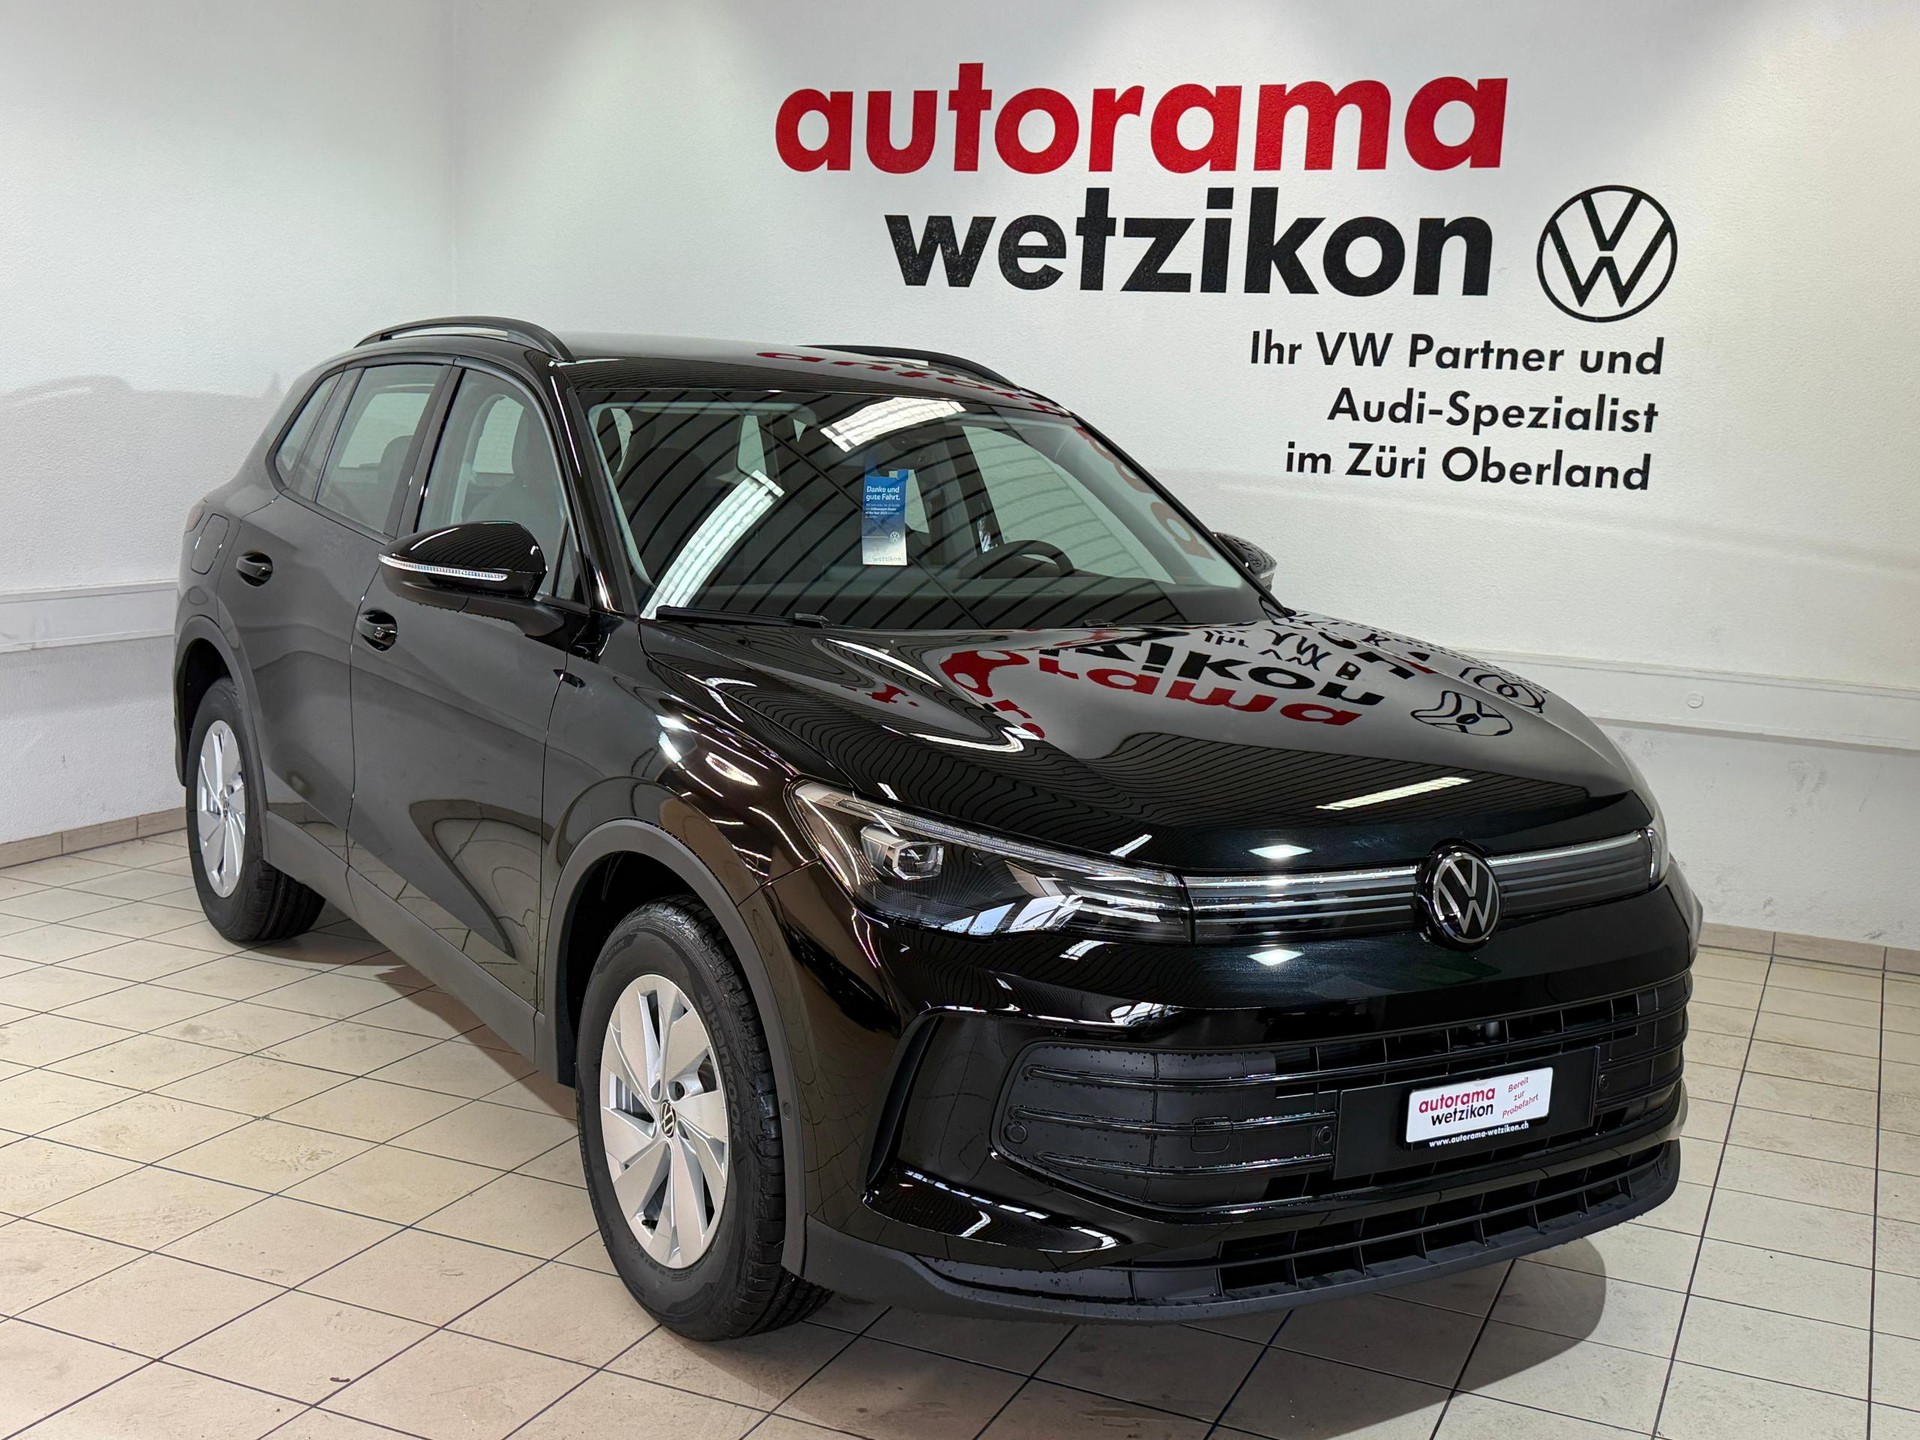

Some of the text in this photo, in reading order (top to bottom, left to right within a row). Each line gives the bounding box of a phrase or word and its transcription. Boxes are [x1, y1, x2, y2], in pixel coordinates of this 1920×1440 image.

[776, 64, 1507, 174] autorama
[885, 188, 1492, 297] wetzikon
[1251, 329, 1665, 375] Ihr VW Partner und
[1327, 387, 1659, 436] Audi-Spezialist
[1286, 441, 1651, 491] im Züri Oberland
[866, 485, 886, 493] Danke
[866, 493, 901, 502] gute Fahrt.
[1508, 1076, 1529, 1093] Bereit
[1514, 1091, 1525, 1101] zur
[1418, 1088, 1495, 1113] autorama
[1502, 1094, 1539, 1118] Probefahrt
[1431, 1104, 1493, 1126] wetzikon
[1428, 1120, 1530, 1148] www.autorama-wetzikon.ch
